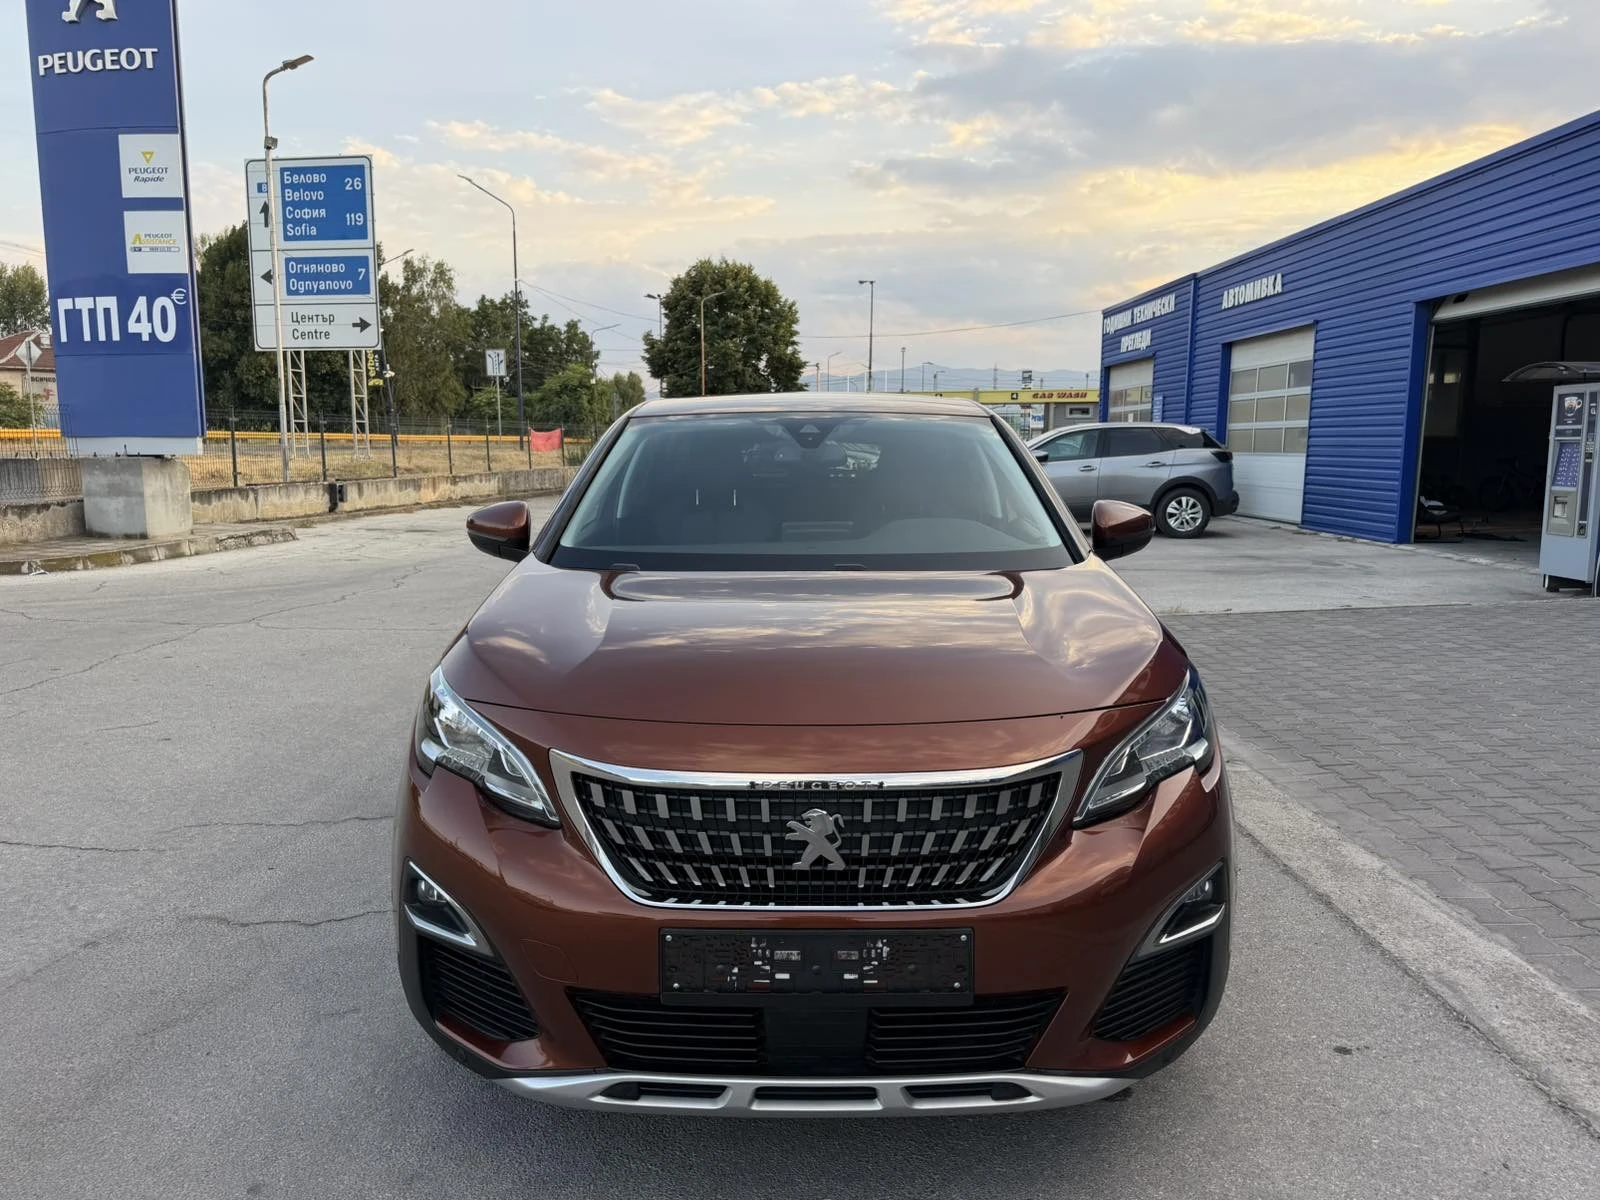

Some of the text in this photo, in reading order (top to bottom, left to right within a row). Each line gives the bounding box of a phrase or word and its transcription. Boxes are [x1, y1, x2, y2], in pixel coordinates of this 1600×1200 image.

[37, 47, 158, 76] PEUGEOT
[133, 175, 165, 183] Rapide
[284, 171, 327, 184] Белово
[344, 177, 362, 190] 26
[285, 189, 324, 201] Belovo
[286, 206, 326, 219] София
[346, 213, 364, 226] 119
[286, 224, 317, 236] Sofia
[288, 262, 345, 273] Огняново
[358, 268, 366, 280] 7
[289, 278, 353, 293] Ognyanovo
[1221, 273, 1283, 310] АВТОМИВКА
[1133, 292, 1176, 324] ТЕХНИЧЕСКИ
[57, 296, 120, 343] ГТП
[291, 312, 335, 324] Център
[292, 328, 331, 340] Centre
[1056, 391, 1088, 399] WASH
[761, 781, 872, 790] PEUGEOT
